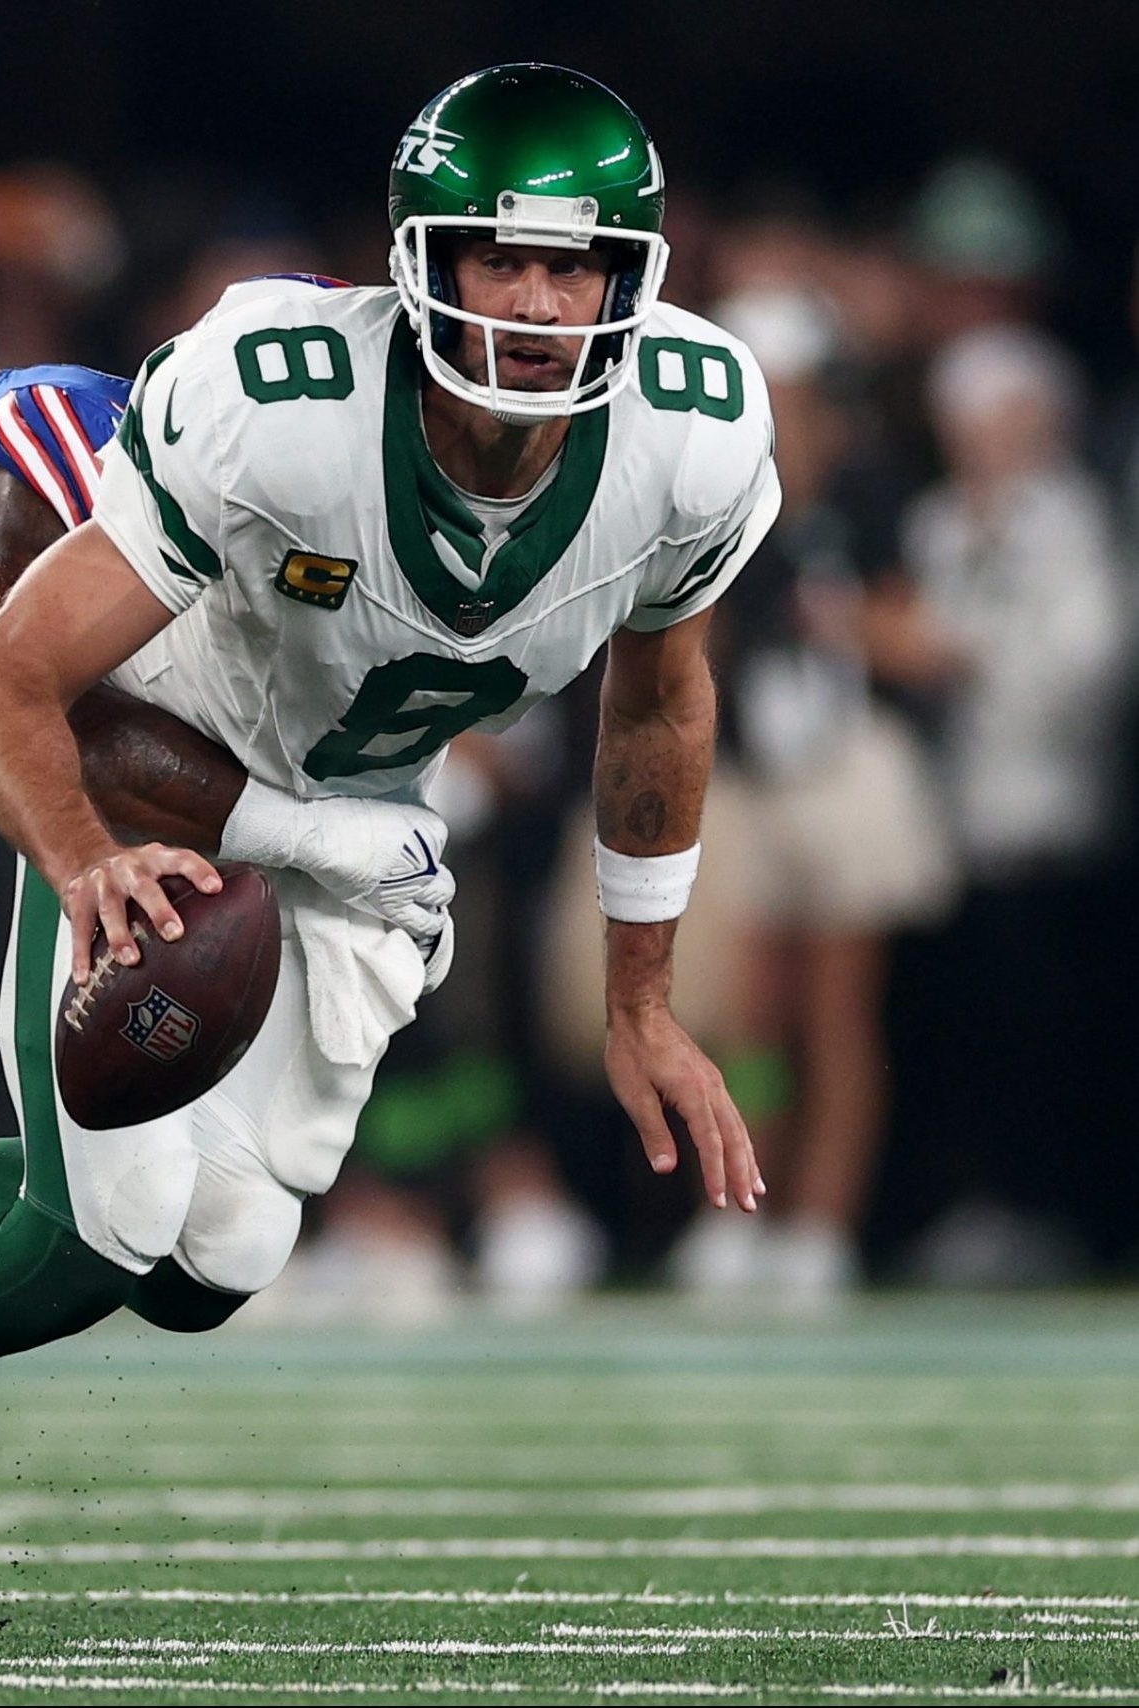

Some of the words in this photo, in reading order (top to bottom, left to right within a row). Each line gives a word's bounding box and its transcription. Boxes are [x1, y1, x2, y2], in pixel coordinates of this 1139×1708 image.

[234, 324, 355, 405] 8
[638, 336, 743, 422] 8
[284, 554, 350, 595] C
[302, 652, 529, 782] 8
[145, 1011, 196, 1060] NFL
